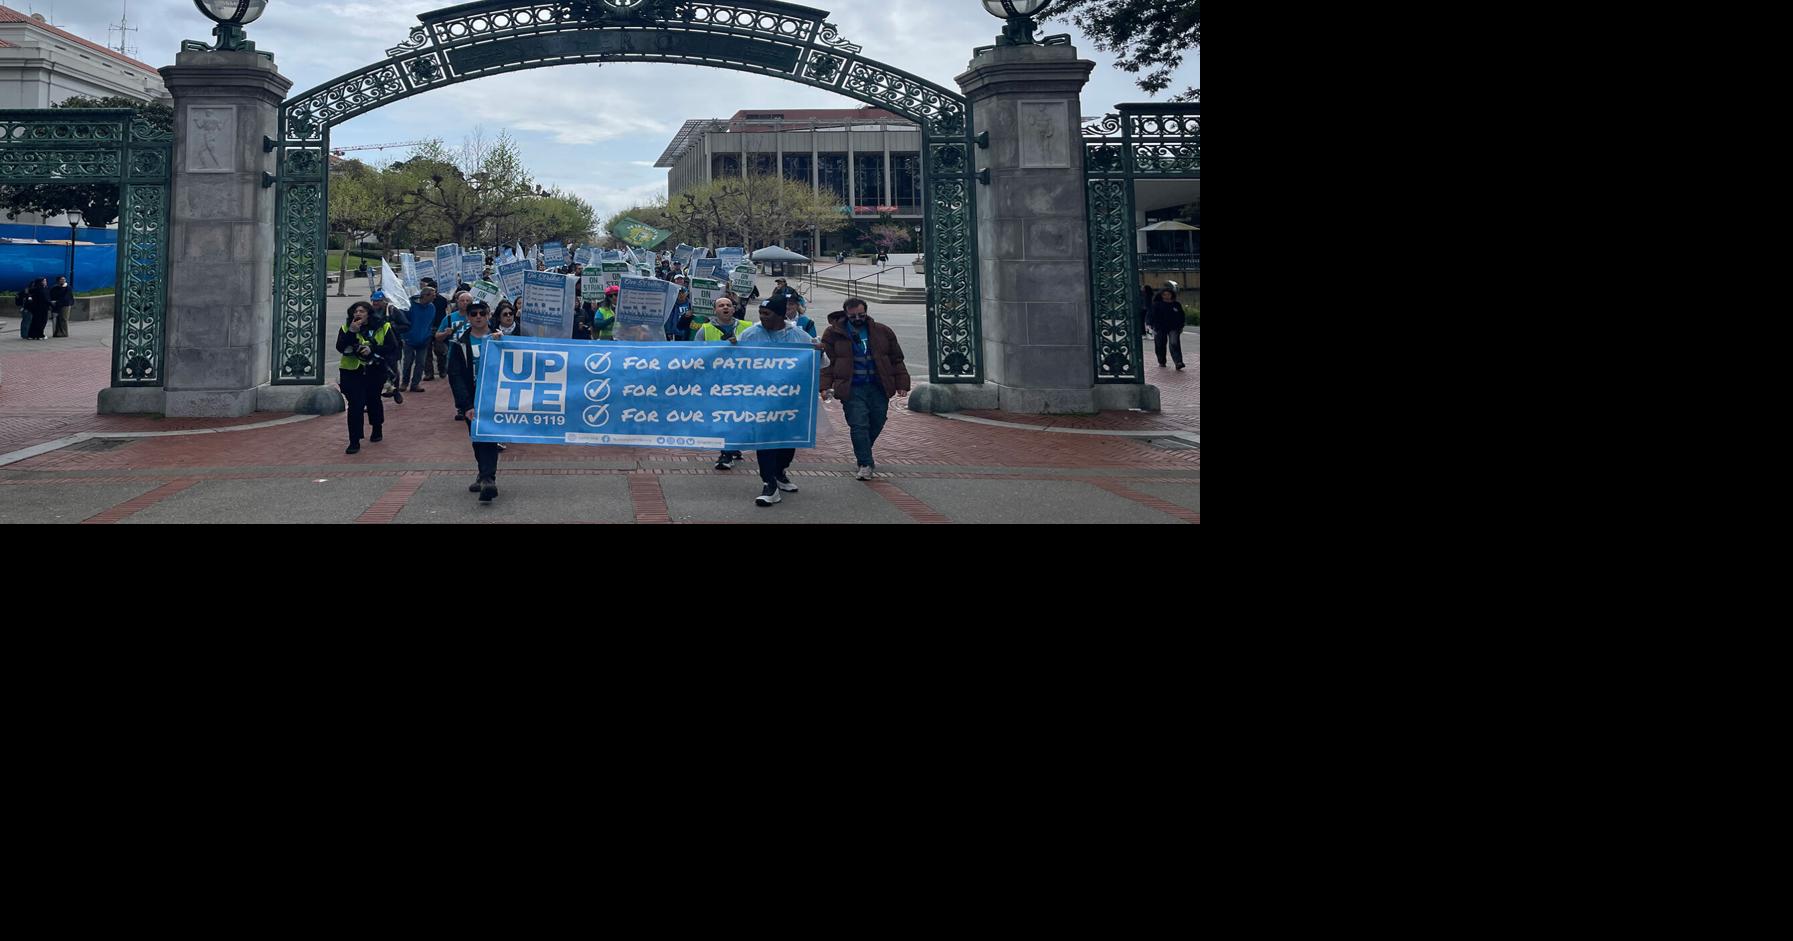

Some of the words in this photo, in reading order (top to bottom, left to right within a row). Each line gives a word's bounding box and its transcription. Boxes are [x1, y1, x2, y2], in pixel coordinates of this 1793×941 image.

[589, 276, 598, 284] ON
[701, 290, 710, 298] ON
[694, 298, 714, 306] STRIK
[502, 352, 565, 381] UP
[623, 356, 660, 370] FOR
[667, 356, 705, 370] OUR
[712, 357, 798, 370] PATIENTS
[500, 381, 562, 412] TE
[622, 384, 658, 397] FOR
[665, 384, 702, 397] OUR
[710, 384, 801, 397] RESEARCH
[493, 413, 529, 425] CWA
[533, 415, 566, 426] 9119
[621, 408, 659, 423] FOR
[666, 409, 704, 423] OUR
[711, 409, 798, 423] STUDENTS
